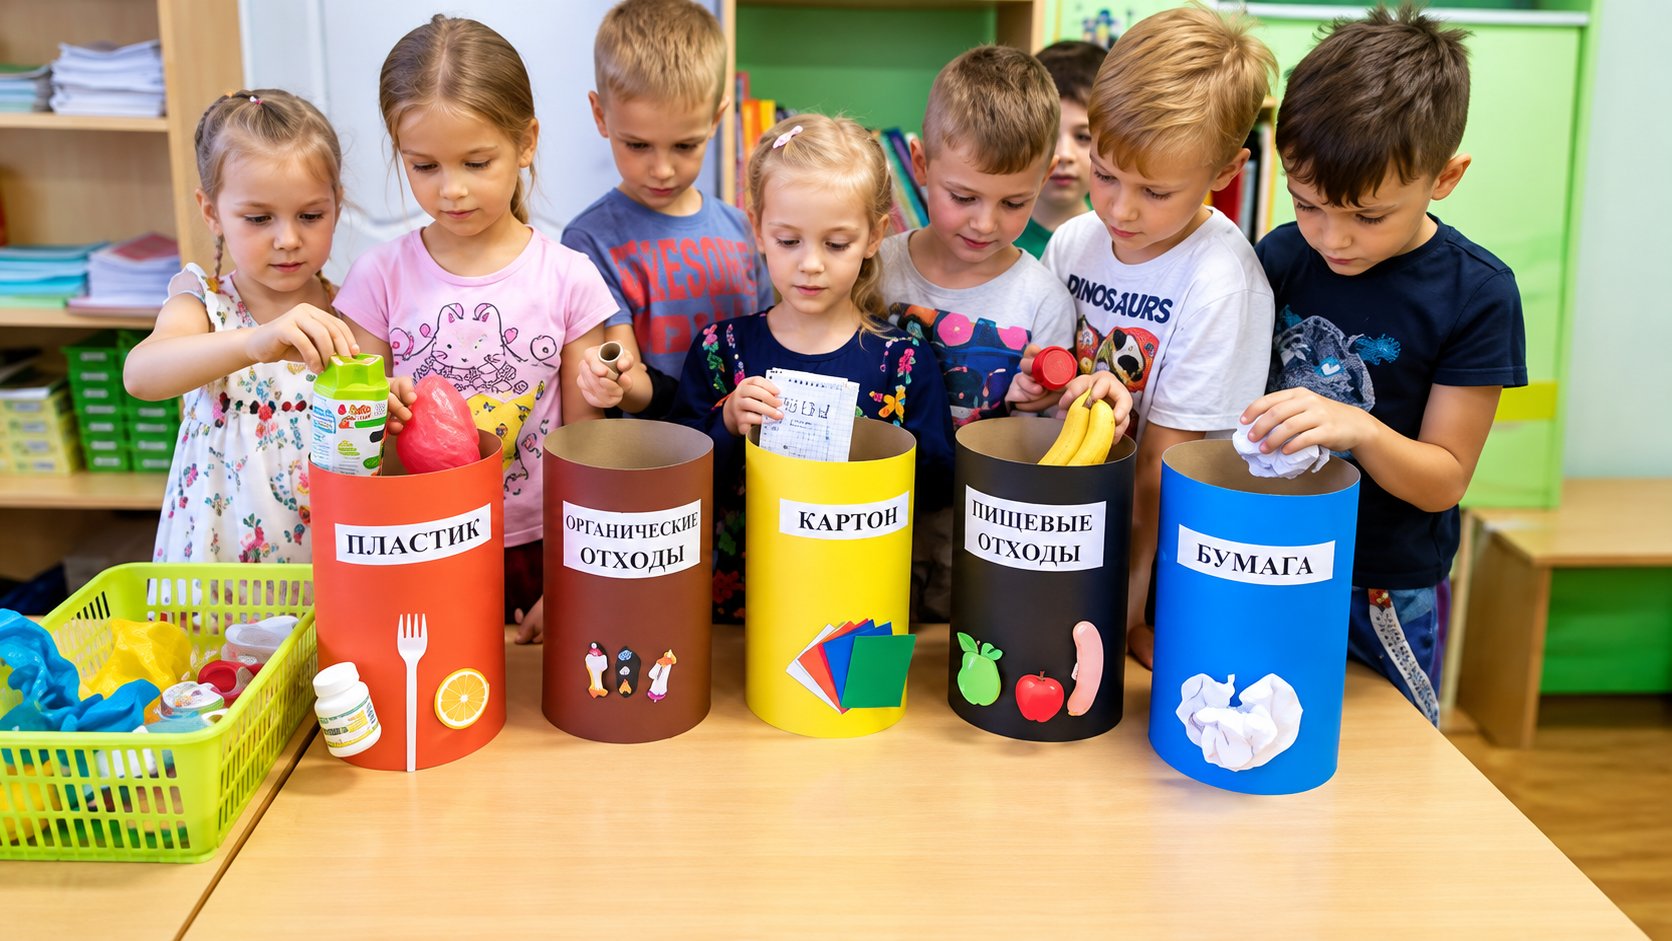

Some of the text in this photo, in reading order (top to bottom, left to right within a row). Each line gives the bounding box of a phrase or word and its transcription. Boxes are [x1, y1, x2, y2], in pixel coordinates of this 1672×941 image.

[1067, 273, 1174, 324] DINOSAURS
[566, 512, 698, 539] ОРГАНИЧЕСКИЕ
[798, 506, 898, 531] КАРТОН
[972, 500, 1093, 532] ПИЩЕВЫЕ
[346, 518, 480, 555] ПЛАСТИК
[978, 532, 1081, 567] ОТХОДЫ
[580, 545, 685, 573] ОТХОДЫ
[1196, 543, 1313, 575] БУМАГА
